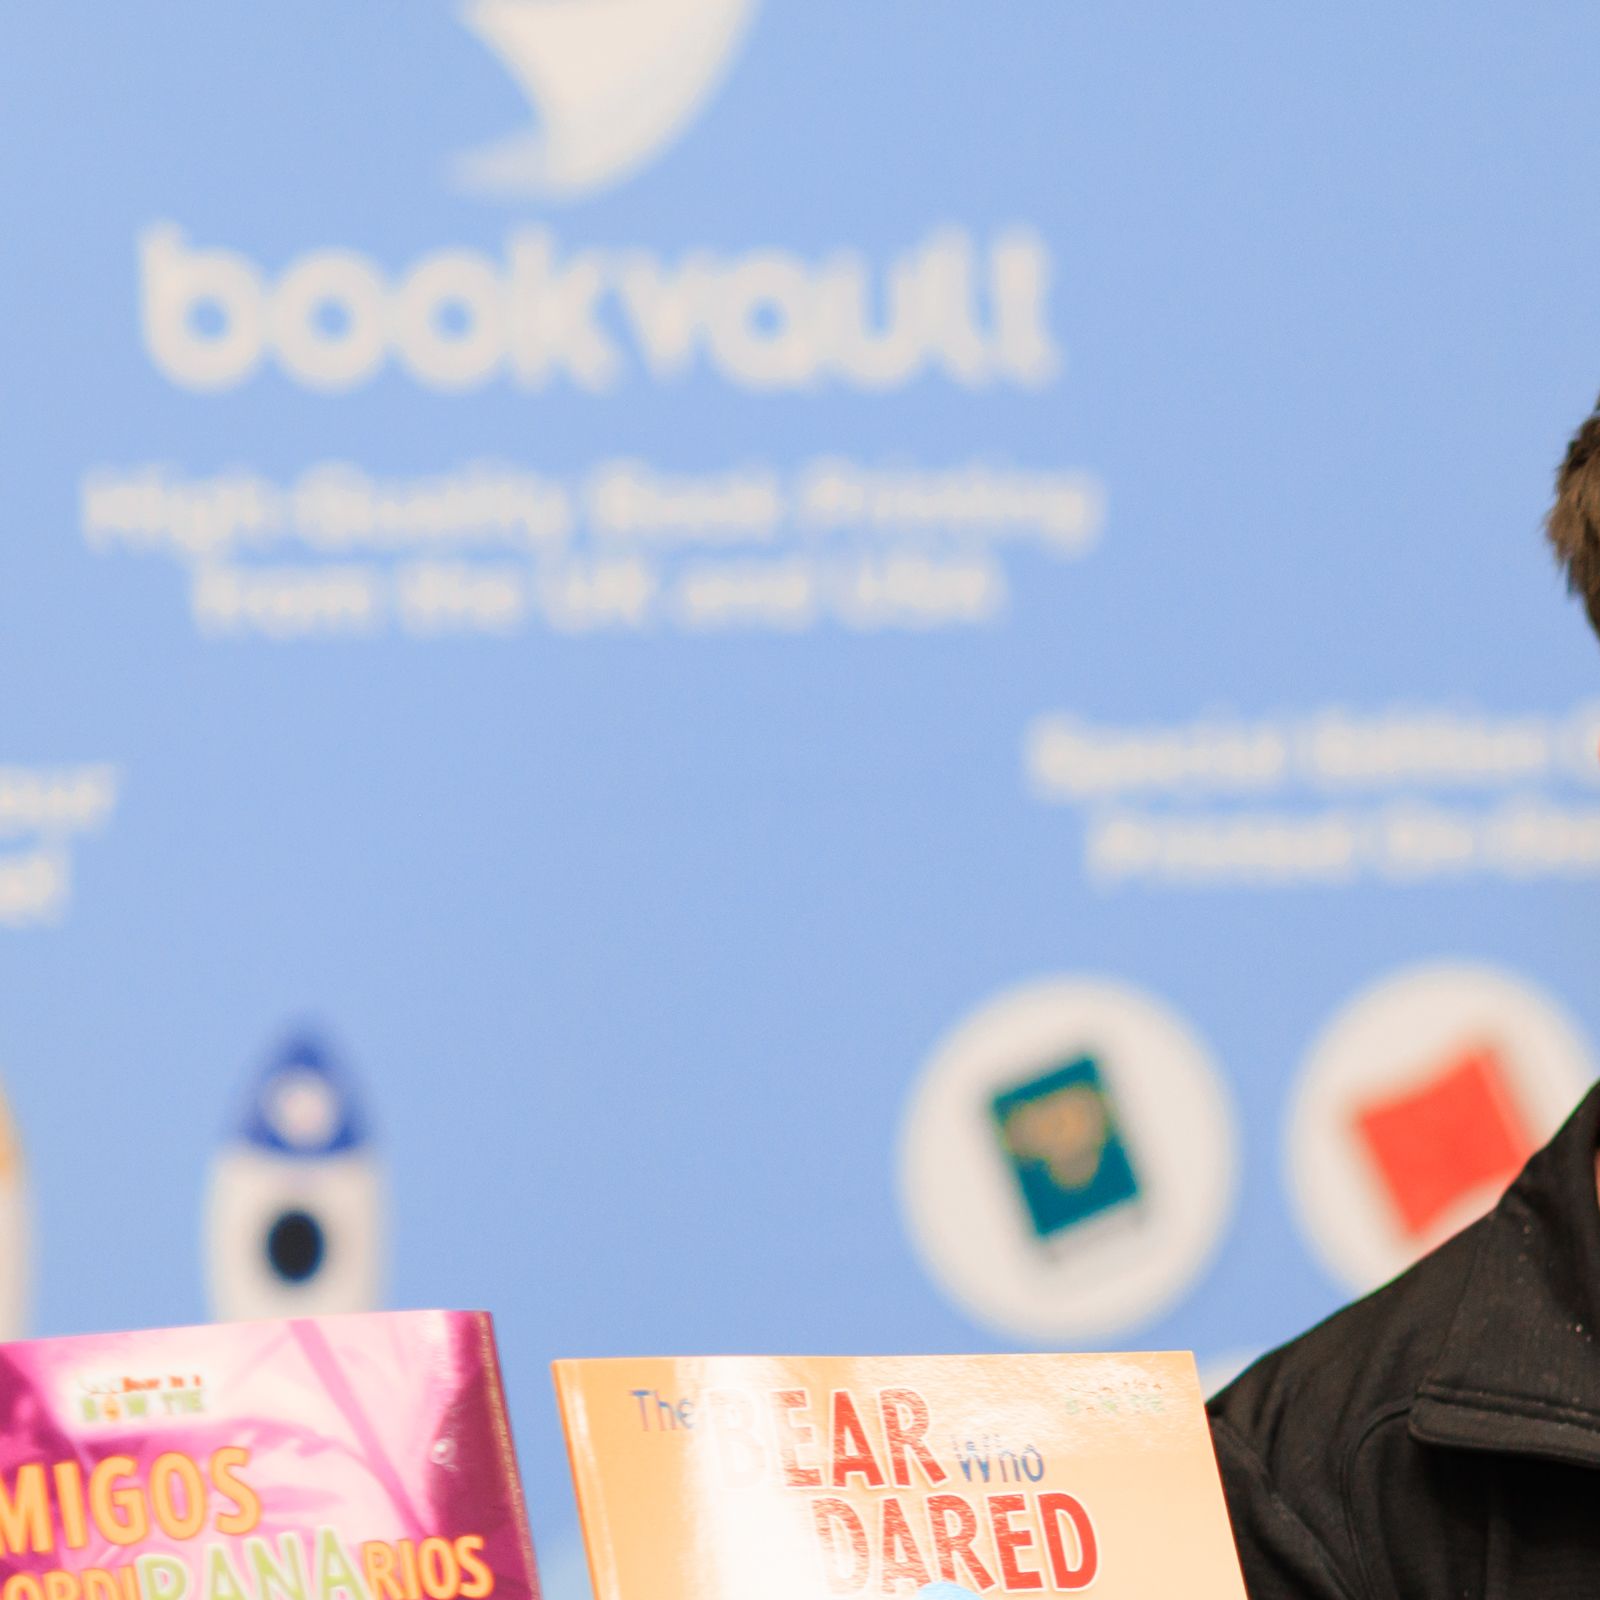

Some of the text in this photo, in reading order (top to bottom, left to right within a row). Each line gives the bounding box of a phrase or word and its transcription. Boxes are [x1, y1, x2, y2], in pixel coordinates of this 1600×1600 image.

[139, 220, 1060, 389] bookvault
[0, 1446, 263, 1557] MIGOS
[952, 1432, 1046, 1484] Who
[811, 1491, 1100, 1598] DARED
